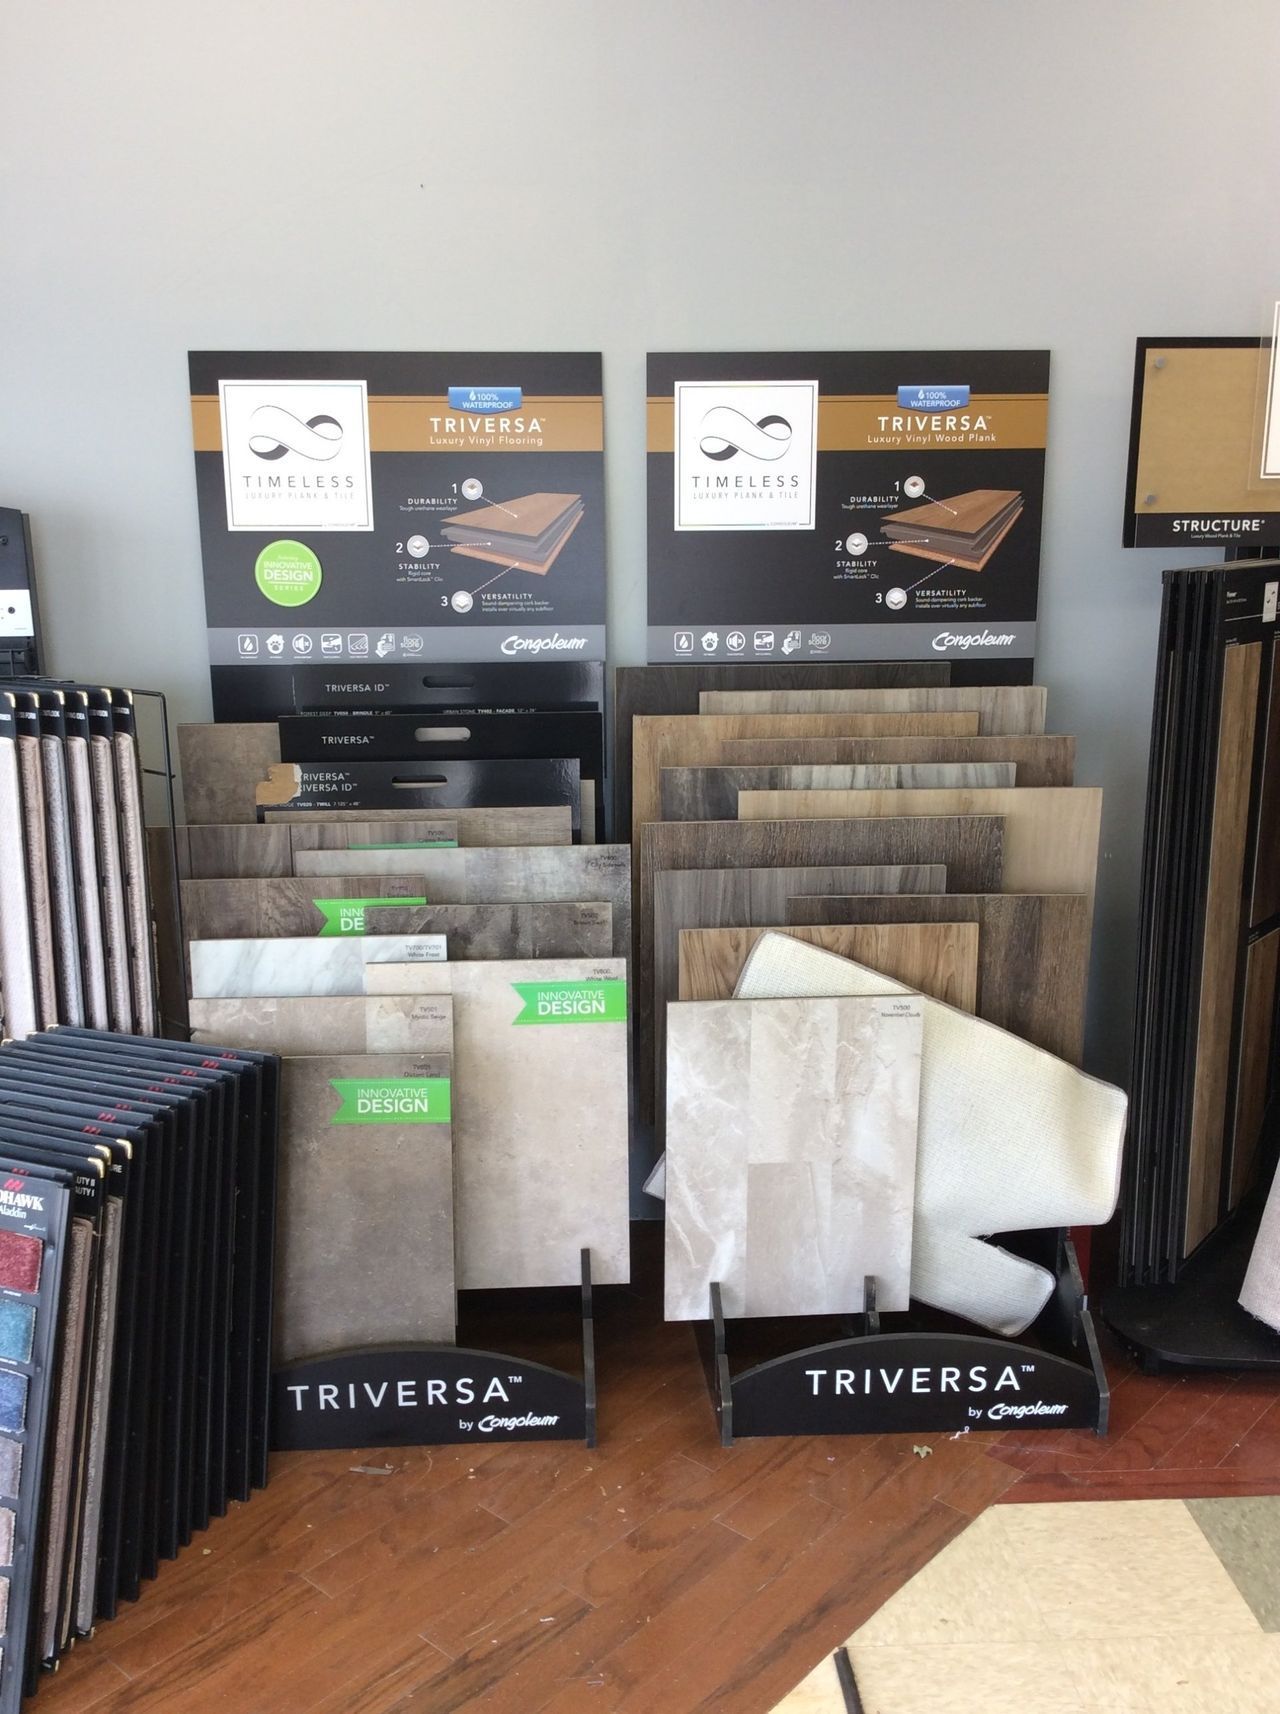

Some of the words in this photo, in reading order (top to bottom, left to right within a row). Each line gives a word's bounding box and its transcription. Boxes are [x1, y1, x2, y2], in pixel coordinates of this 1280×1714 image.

[477, 392, 499, 401] 100%
[925, 392, 947, 400] 100%
[430, 436, 465, 446] Luxury
[468, 436, 494, 446] Vinyl
[498, 435, 543, 446] Flooring
[868, 435, 902, 445] Luxury
[906, 434, 930, 445] Vinyl
[935, 434, 964, 442] Wood
[969, 433, 996, 442] Plank
[242, 475, 354, 488] TIMELESS
[692, 475, 799, 488] TIMELESS
[894, 481, 900, 492] 1
[452, 482, 457, 494] 1
[396, 542, 404, 553] 2
[835, 540, 842, 551] 2
[264, 560, 313, 569] INNOVATIVE
[264, 569, 313, 582] DESIGN
[441, 596, 449, 606] 3
[875, 593, 882, 604] 3
[500, 632, 588, 655] Congoleum
[932, 629, 1016, 651] Congoleum
[325, 684, 371, 692] TRIVERSA
[301, 772, 350, 781] RIVERSA™
[538, 990, 605, 1000] INNOVATIVE
[538, 1000, 606, 1015] DESIGN
[357, 1088, 428, 1098] INNOVATIVE
[357, 1099, 428, 1113] DESIGN
[968, 1406, 982, 1419] by
[988, 1401, 1068, 1420] Congoleum
[459, 1419, 474, 1431] by
[478, 1412, 560, 1432] Congoleum
